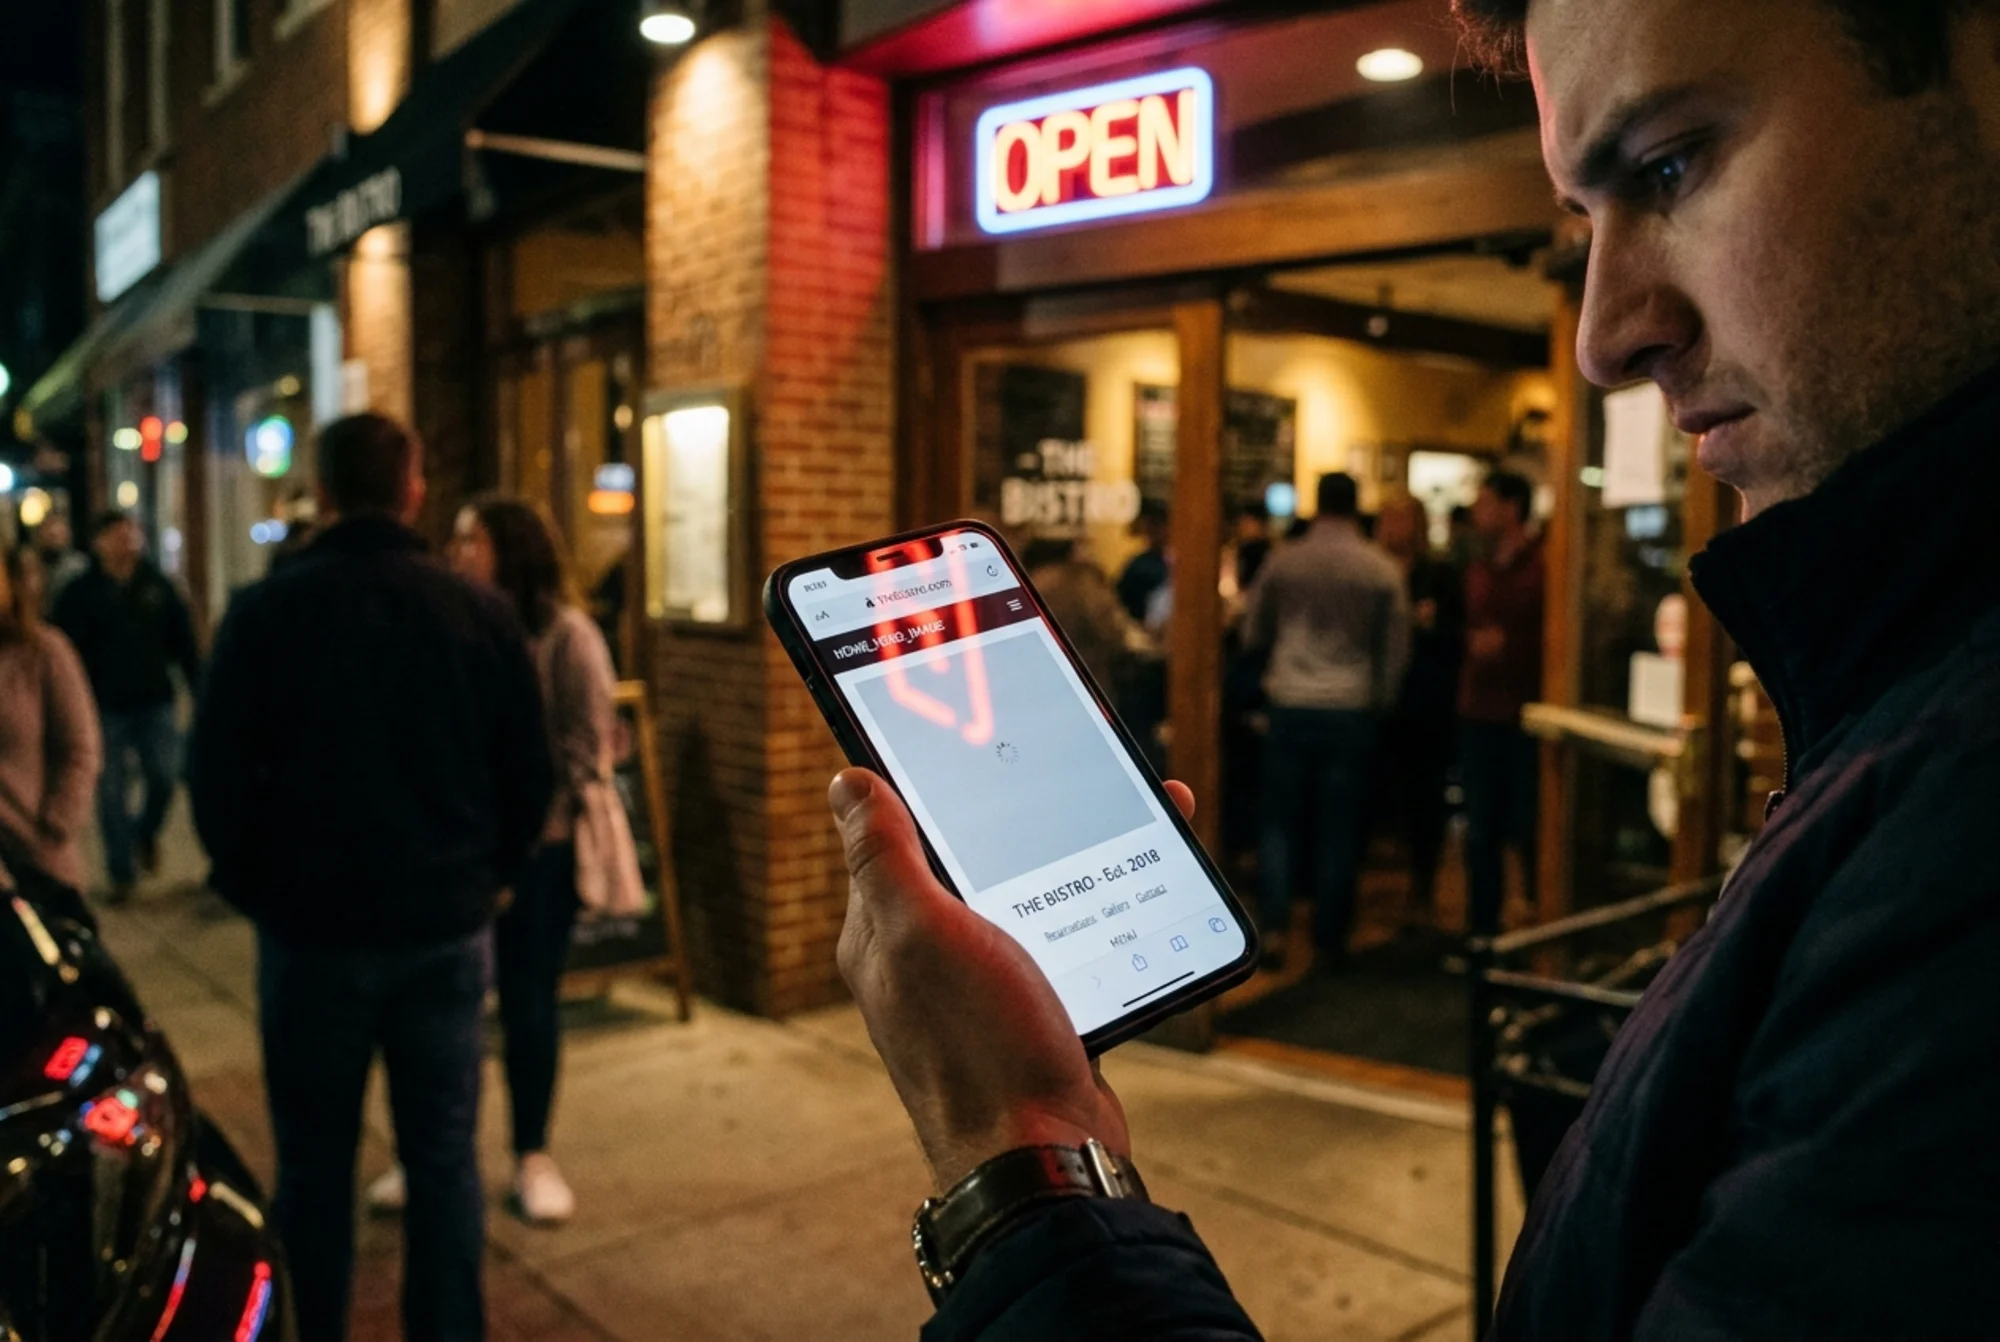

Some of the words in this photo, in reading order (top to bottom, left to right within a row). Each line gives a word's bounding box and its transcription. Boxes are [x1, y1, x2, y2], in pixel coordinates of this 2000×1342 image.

[994, 87, 1197, 213] OPEN
[1012, 896, 1045, 918] THE
[1043, 875, 1096, 906] BISTRO
[1126, 849, 1161, 872] 2018
